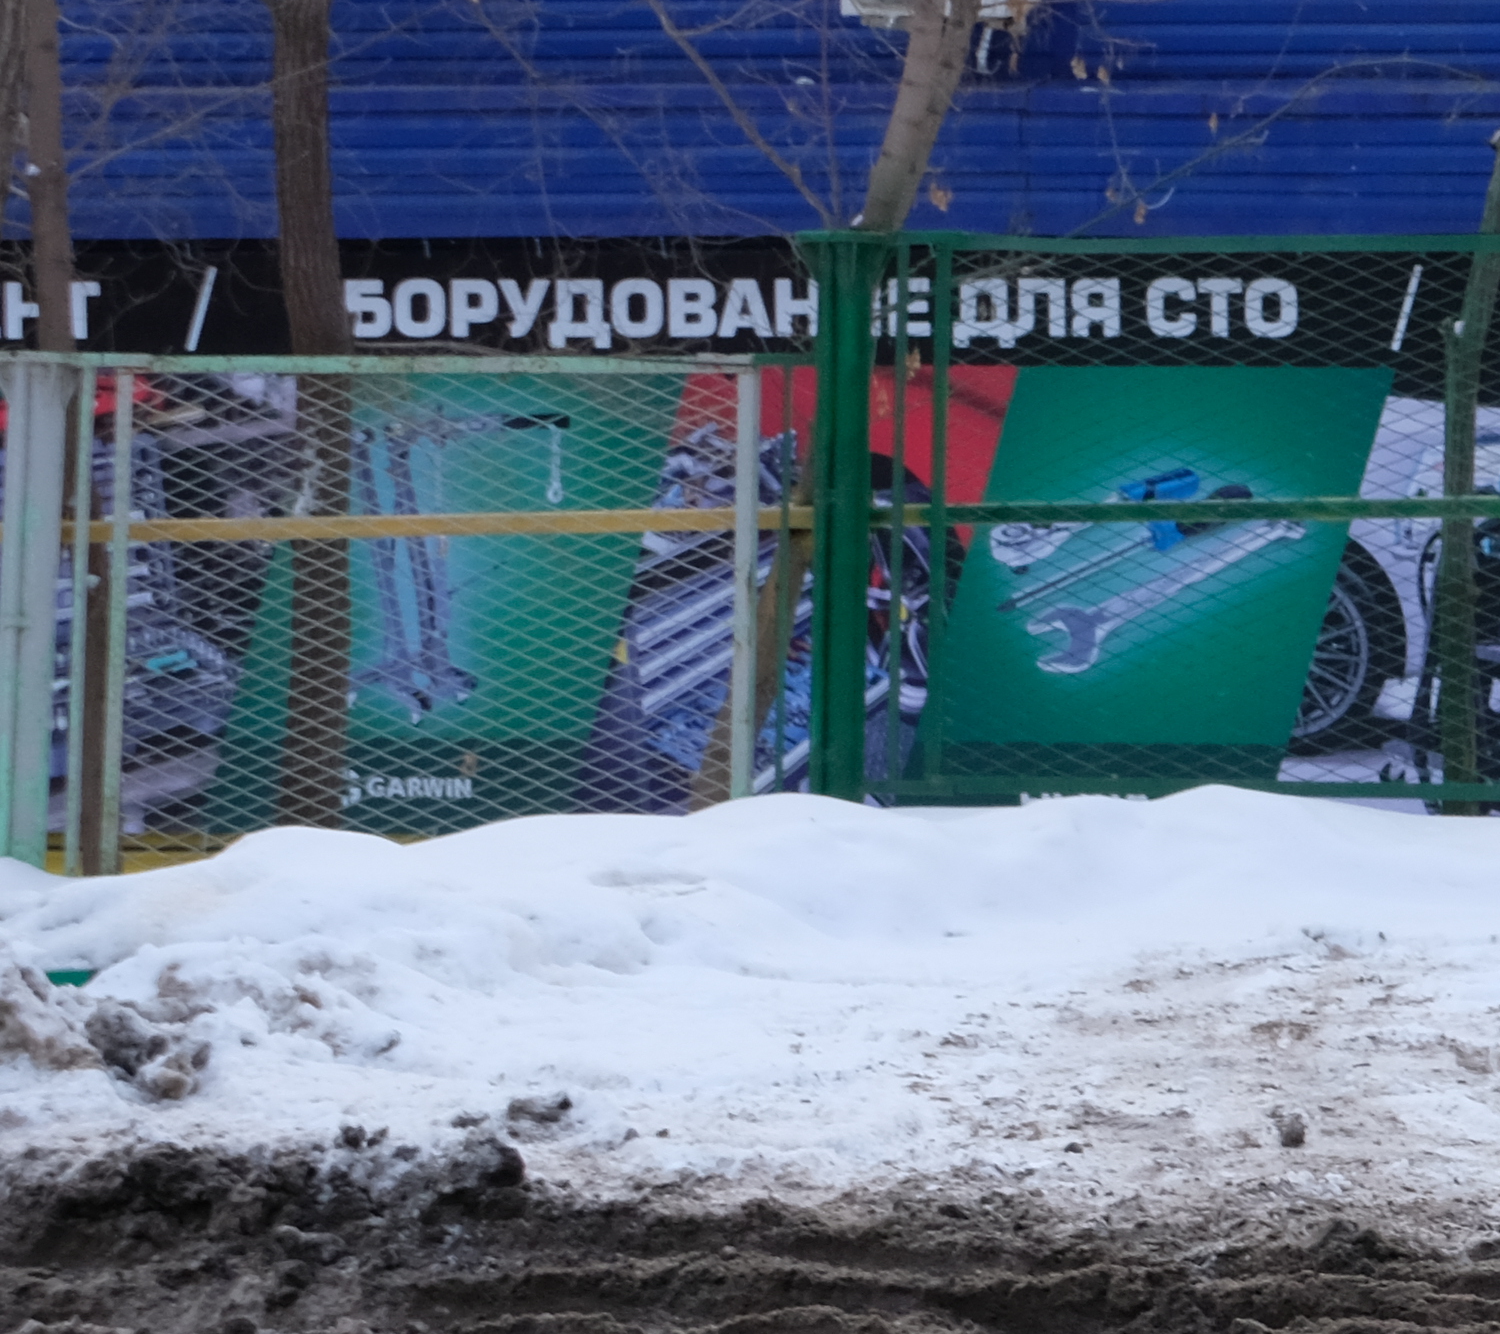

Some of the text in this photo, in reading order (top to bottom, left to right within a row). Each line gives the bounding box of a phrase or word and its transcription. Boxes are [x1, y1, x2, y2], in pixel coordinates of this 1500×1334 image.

[343, 277, 932, 349] БОРУДОВАНЕ
[952, 277, 1121, 349] ДЛЯ
[1146, 277, 1298, 338] СТО
[365, 776, 473, 799] GARWIN
